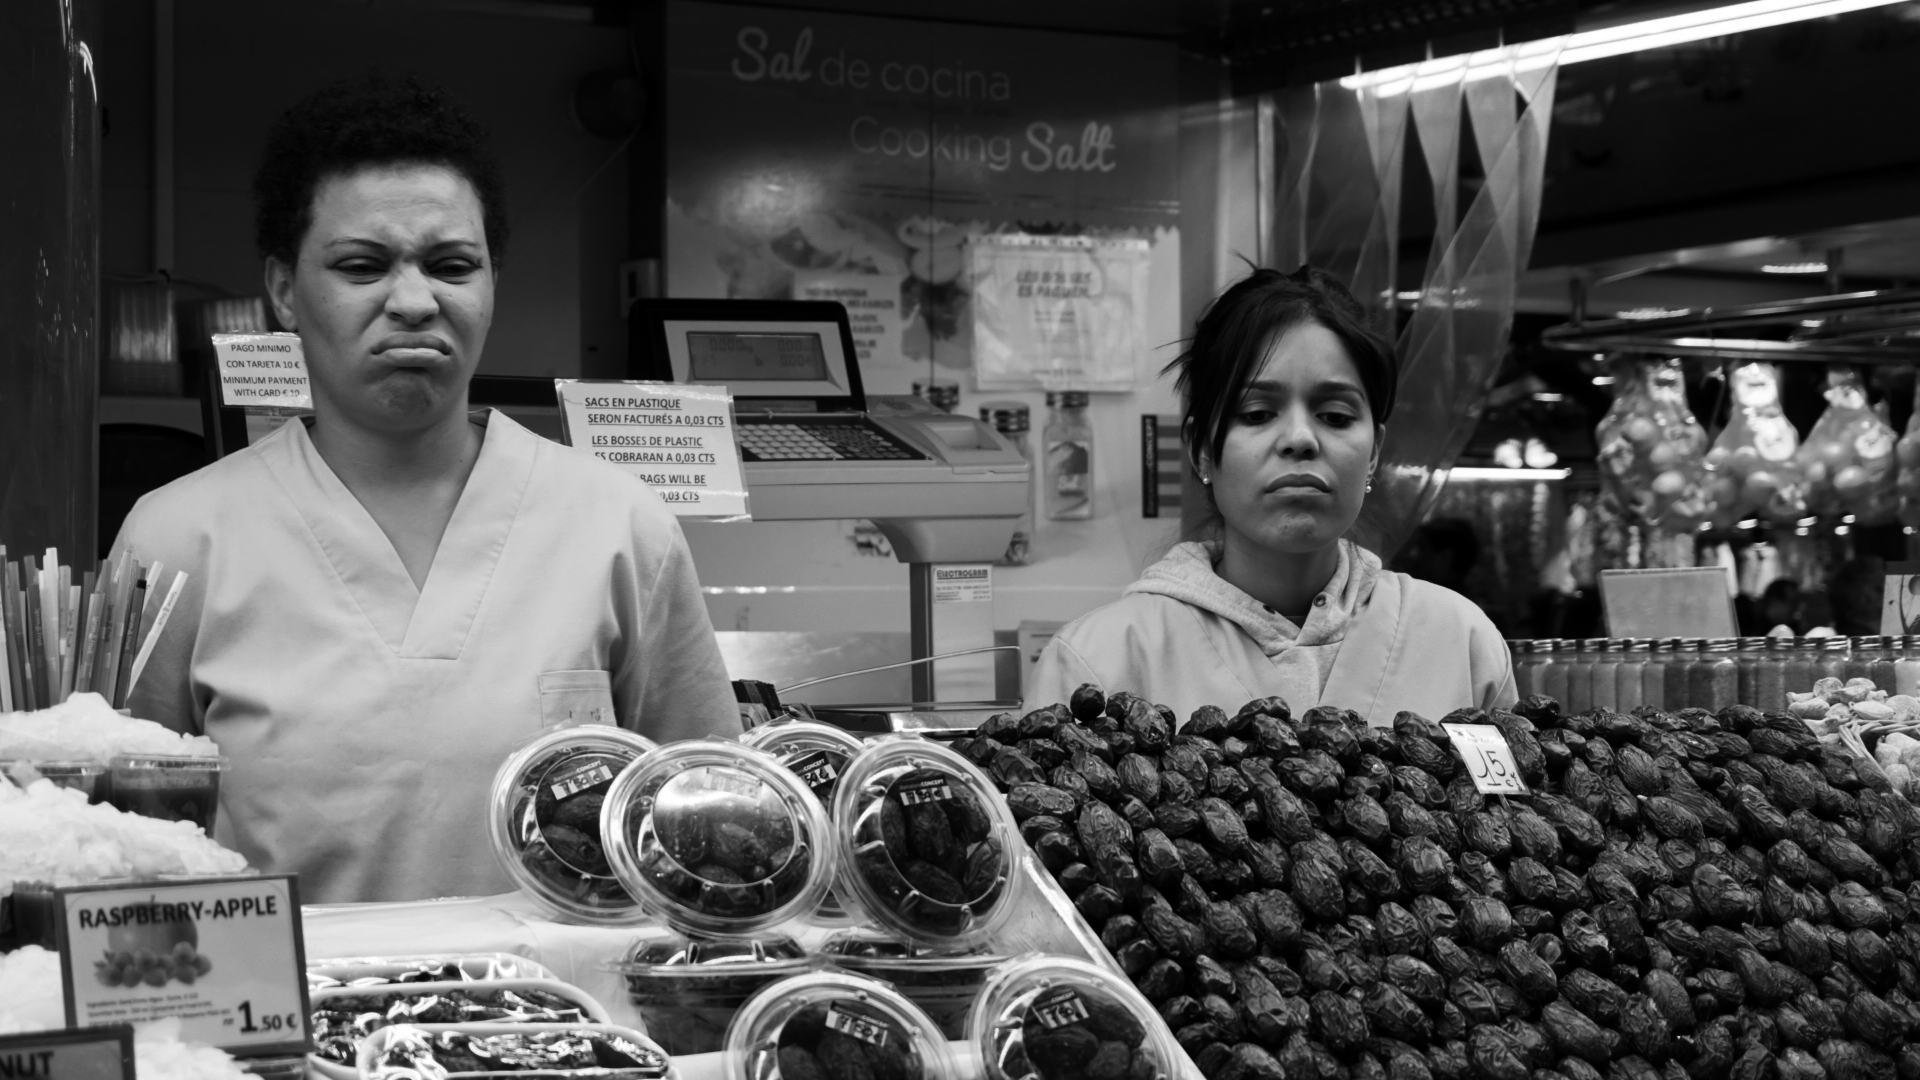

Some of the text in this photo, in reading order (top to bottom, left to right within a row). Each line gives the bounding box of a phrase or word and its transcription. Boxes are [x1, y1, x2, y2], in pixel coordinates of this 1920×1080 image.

[732, 27, 1010, 101] Sal de cocina
[850, 115, 1116, 173] Cooking Salt
[231, 344, 291, 353] PAGO MINIMO
[226, 360, 301, 369] CON TARJETA 10 €
[223, 376, 307, 385] MINIMUM PAYMENT
[233, 389, 257, 397] WITH
[258, 389, 281, 397] CARD
[585, 397, 682, 411] SACS EN PLASTIQUE
[587, 412, 724, 428] SERON FACTURÉS A 0,03 CTS
[591, 435, 704, 447] LES BOSSES DE PLASTIC
[609, 451, 664, 463] COBRARAN
[666, 452, 674, 463] A
[675, 452, 696, 465] 0,03
[698, 453, 715, 464] CTS
[640, 474, 666, 485] BAGS
[668, 474, 692, 485] WILL
[694, 474, 706, 485] BE
[682, 491, 700, 501] CTS
[79, 895, 277, 929] RASPBERRY-APPLE
[286, 1012, 298, 1030] €
